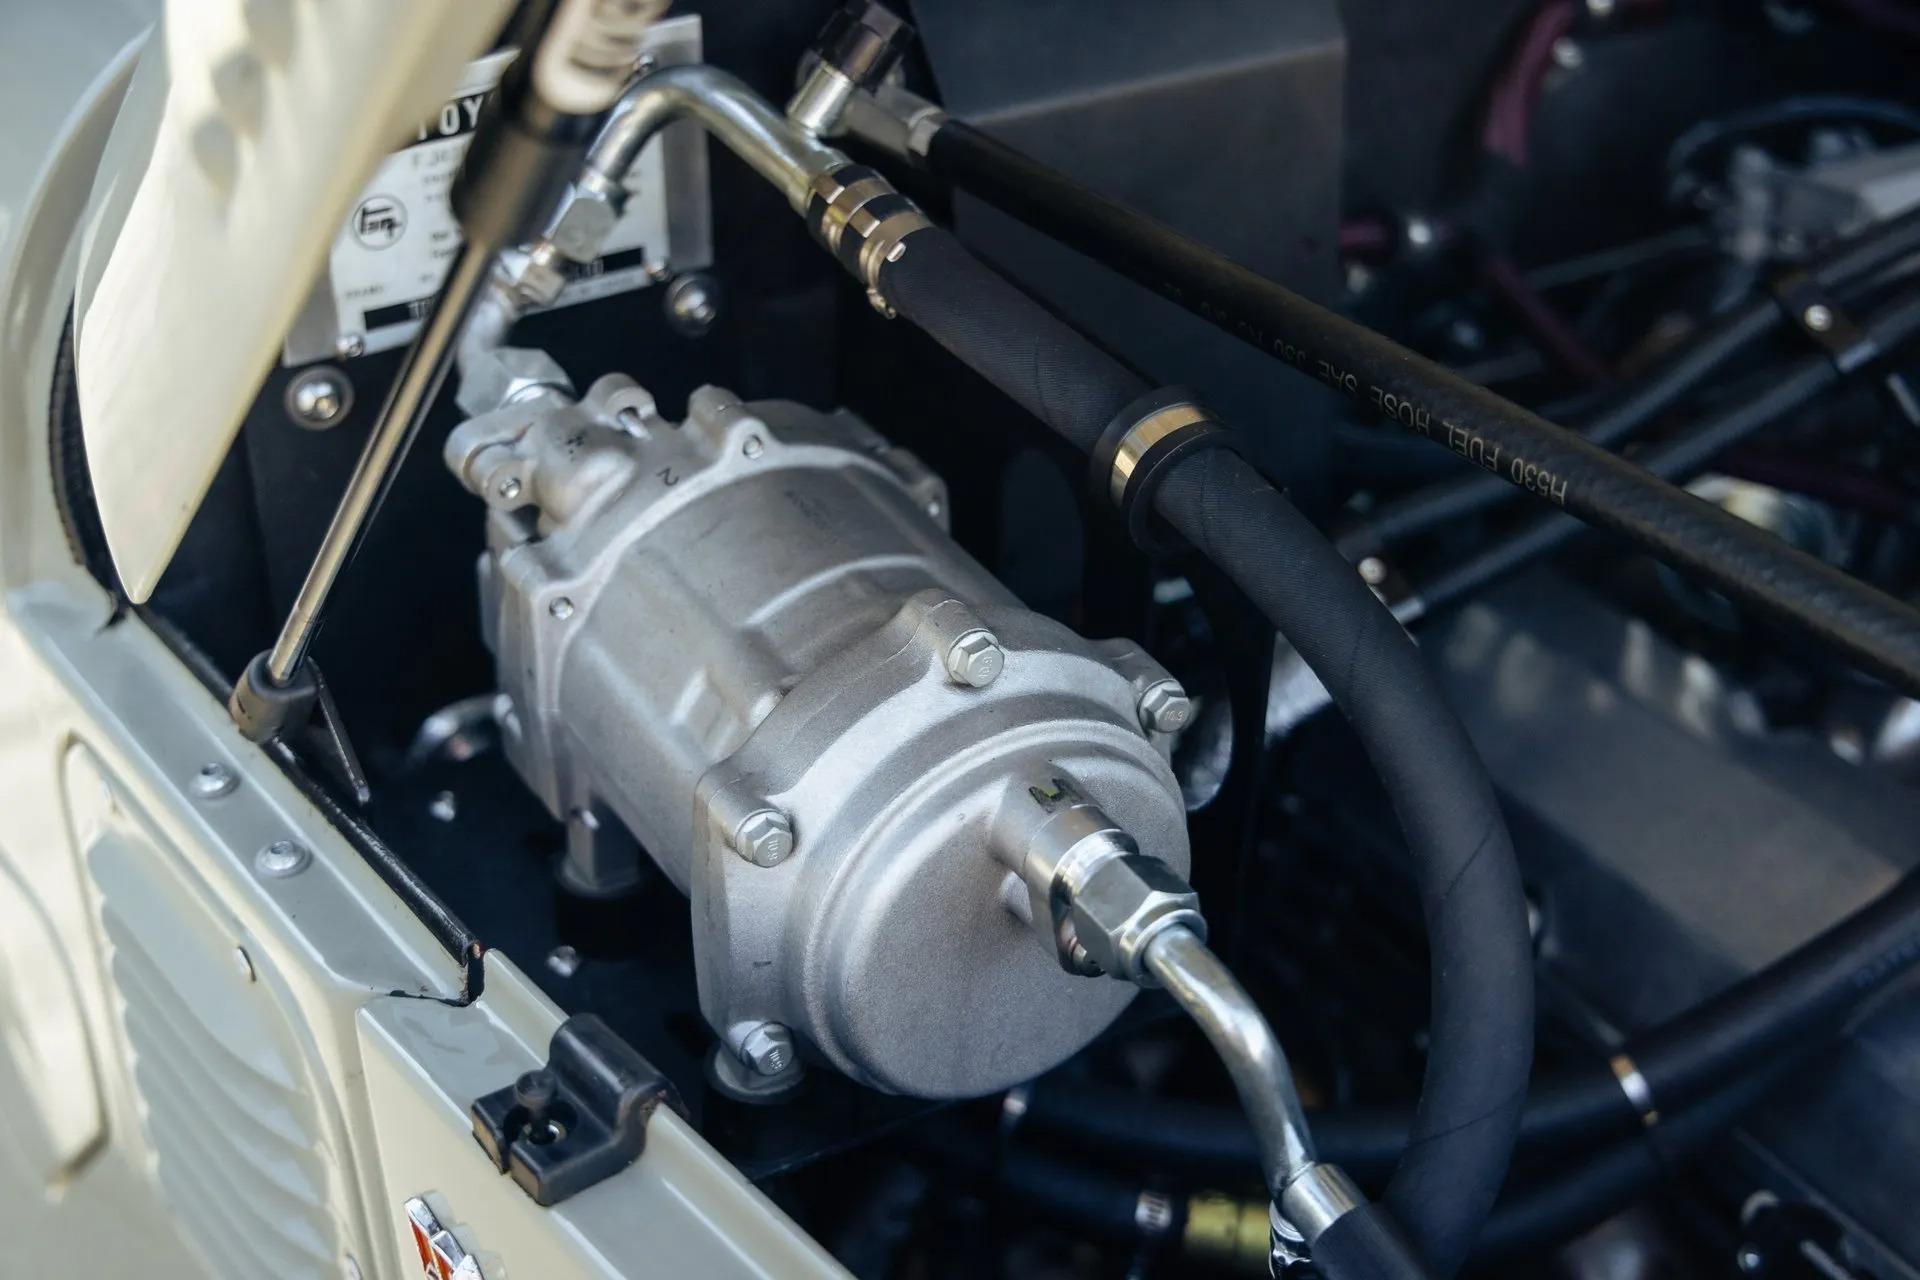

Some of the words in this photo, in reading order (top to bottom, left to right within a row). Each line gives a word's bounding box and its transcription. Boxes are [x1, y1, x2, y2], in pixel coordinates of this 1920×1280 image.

[1318, 360, 1357, 395] SAE
[1371, 385, 1430, 436] HOSE
[1443, 421, 1500, 473] FUEL
[1511, 457, 1567, 505] H530
